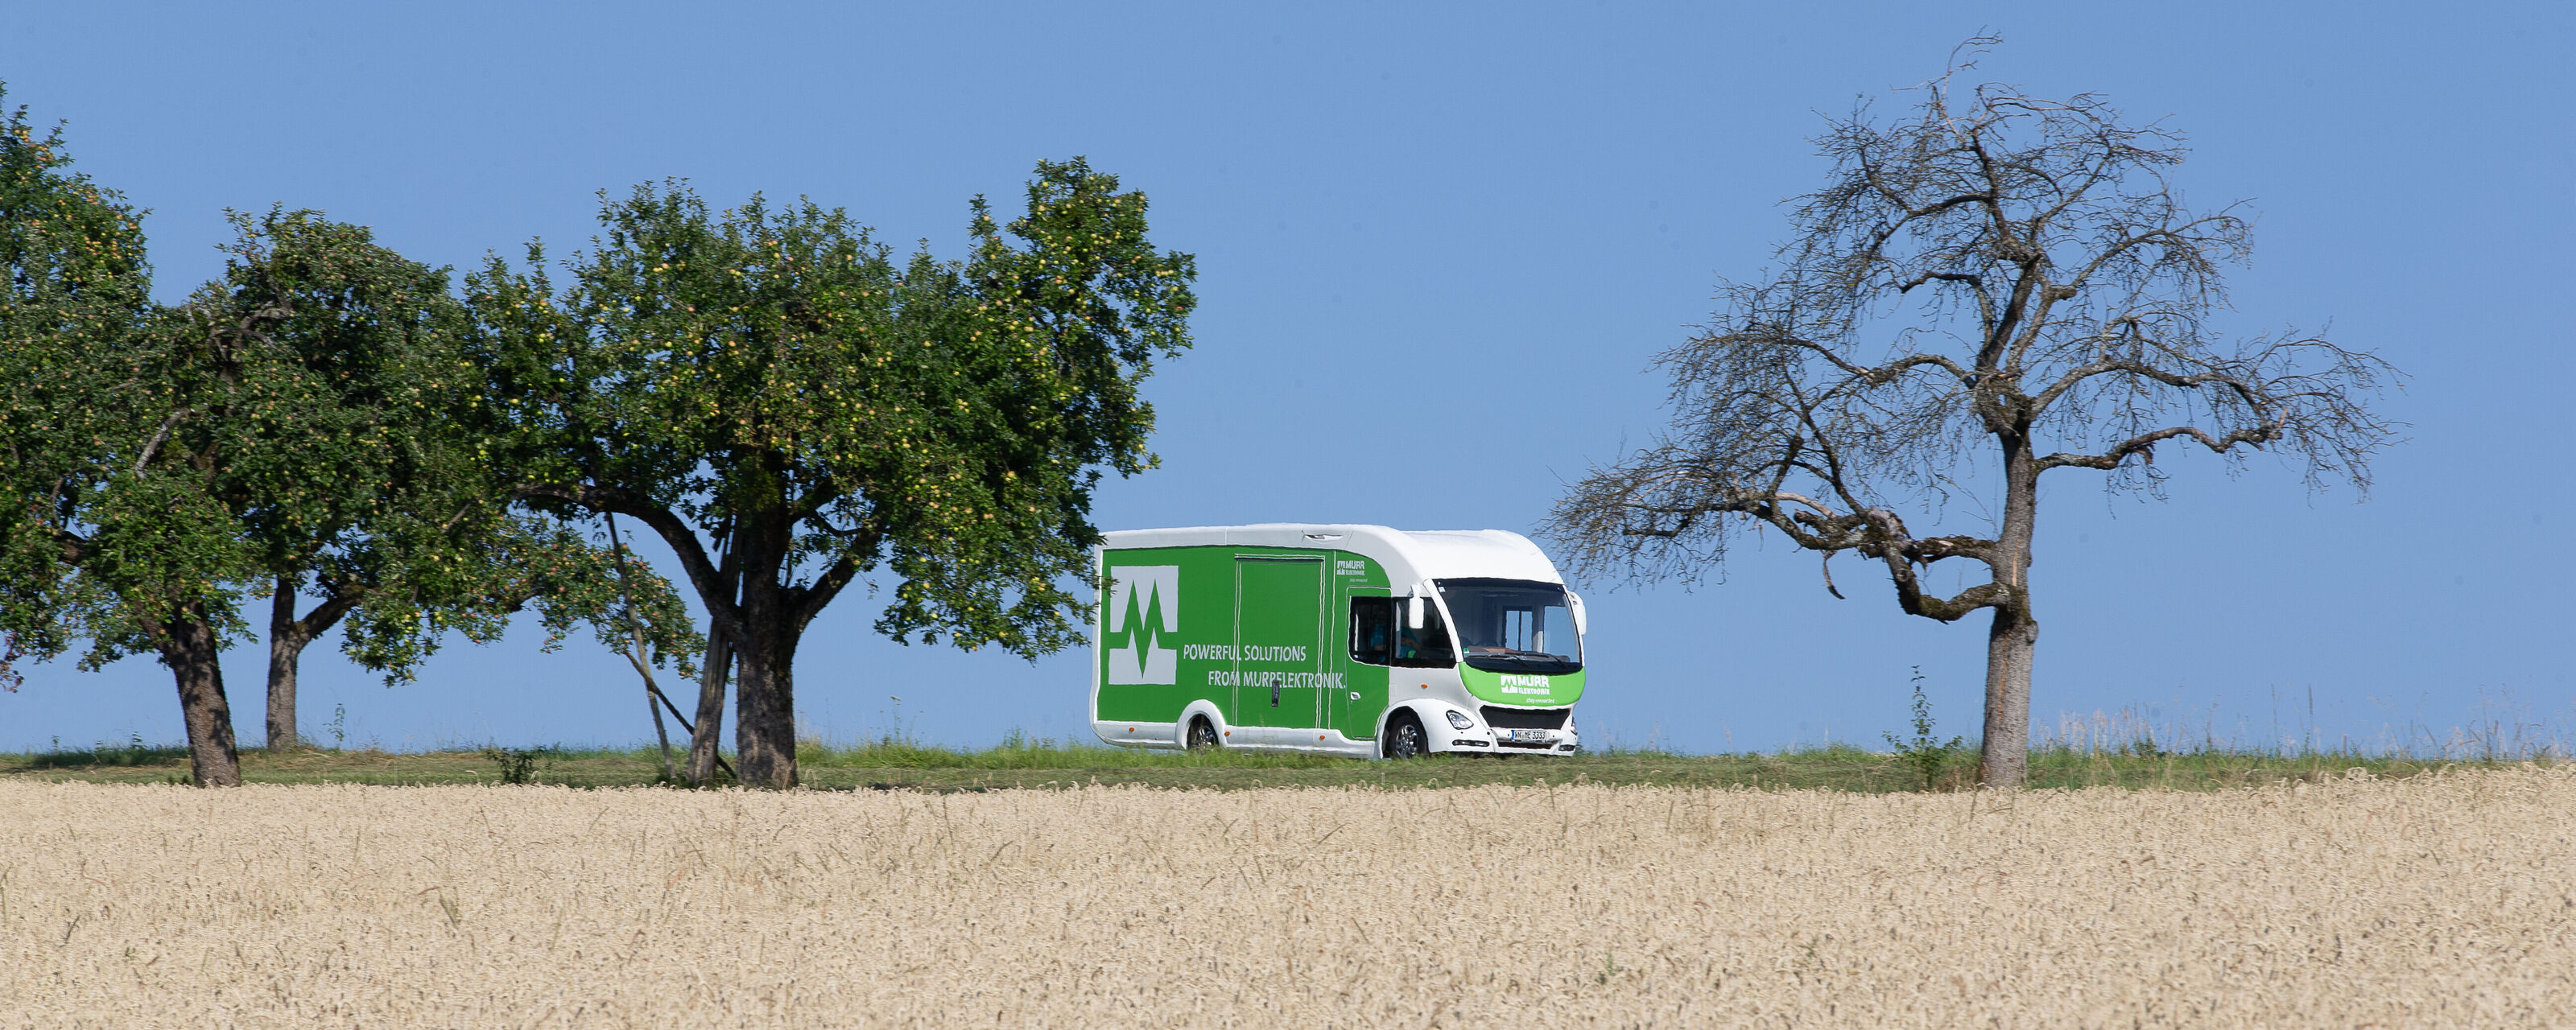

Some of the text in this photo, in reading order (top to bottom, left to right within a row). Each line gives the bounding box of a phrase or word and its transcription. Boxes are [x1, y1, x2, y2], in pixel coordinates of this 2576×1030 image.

[1346, 561, 1364, 570] MURR
[1183, 644, 1307, 661] POWERFUL SOLUTIONS
[1208, 670, 1241, 687] FROM
[1517, 675, 1550, 688] MURR
[1518, 687, 1550, 695] ELEKTRONIK
